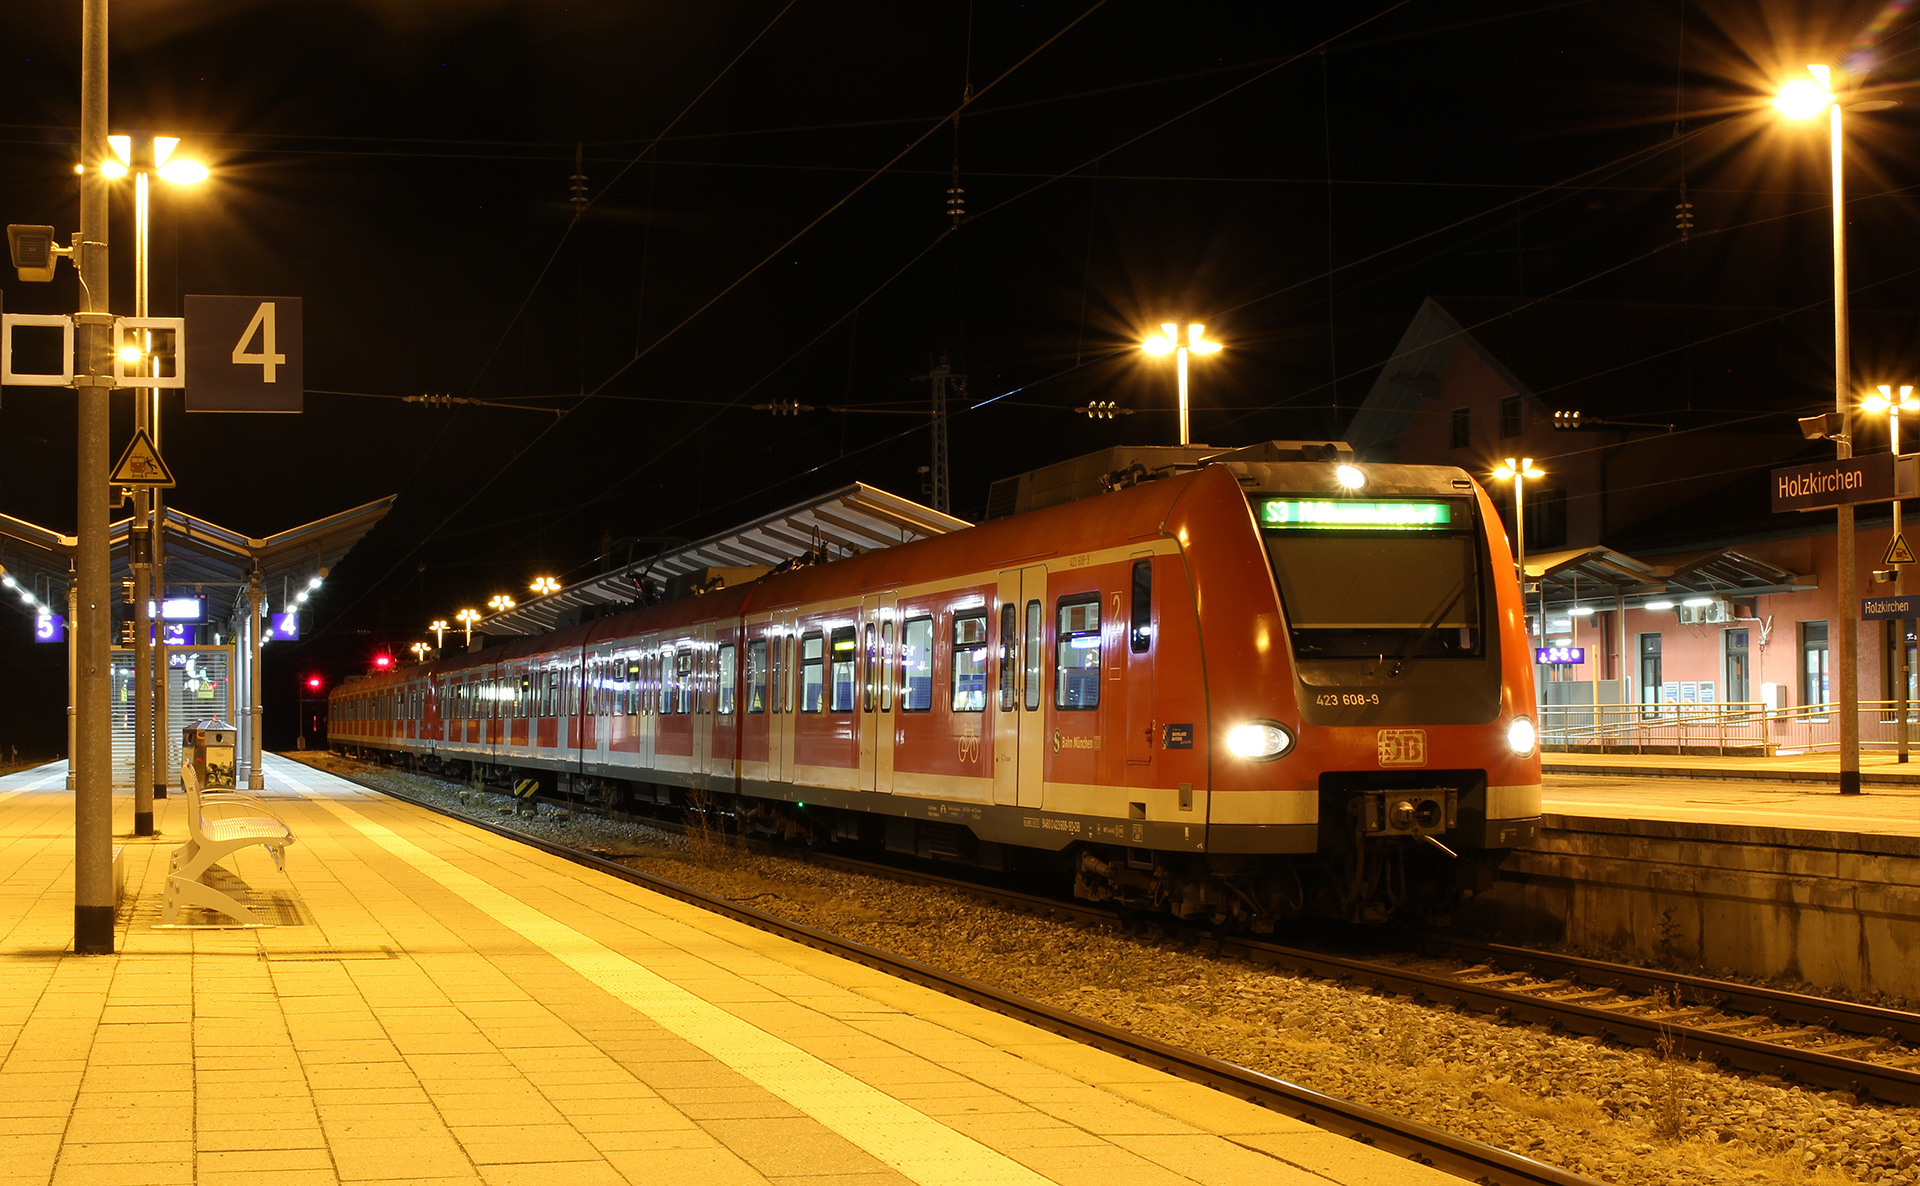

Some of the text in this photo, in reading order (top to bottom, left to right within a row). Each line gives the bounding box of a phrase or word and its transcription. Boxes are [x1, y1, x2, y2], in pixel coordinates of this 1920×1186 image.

[232, 302, 286, 383] 4
[1778, 468, 1863, 499] Holzkirchen
[1266, 501, 1288, 522] S3
[1864, 600, 1909, 614] Holzkirchen
[37, 614, 54, 639] 5
[281, 613, 297, 636] 4
[1316, 693, 1380, 706] 423 608-9
[1062, 736, 1073, 748] Bahn
[1073, 736, 1093, 749] München
[1382, 733, 1423, 763] DB
